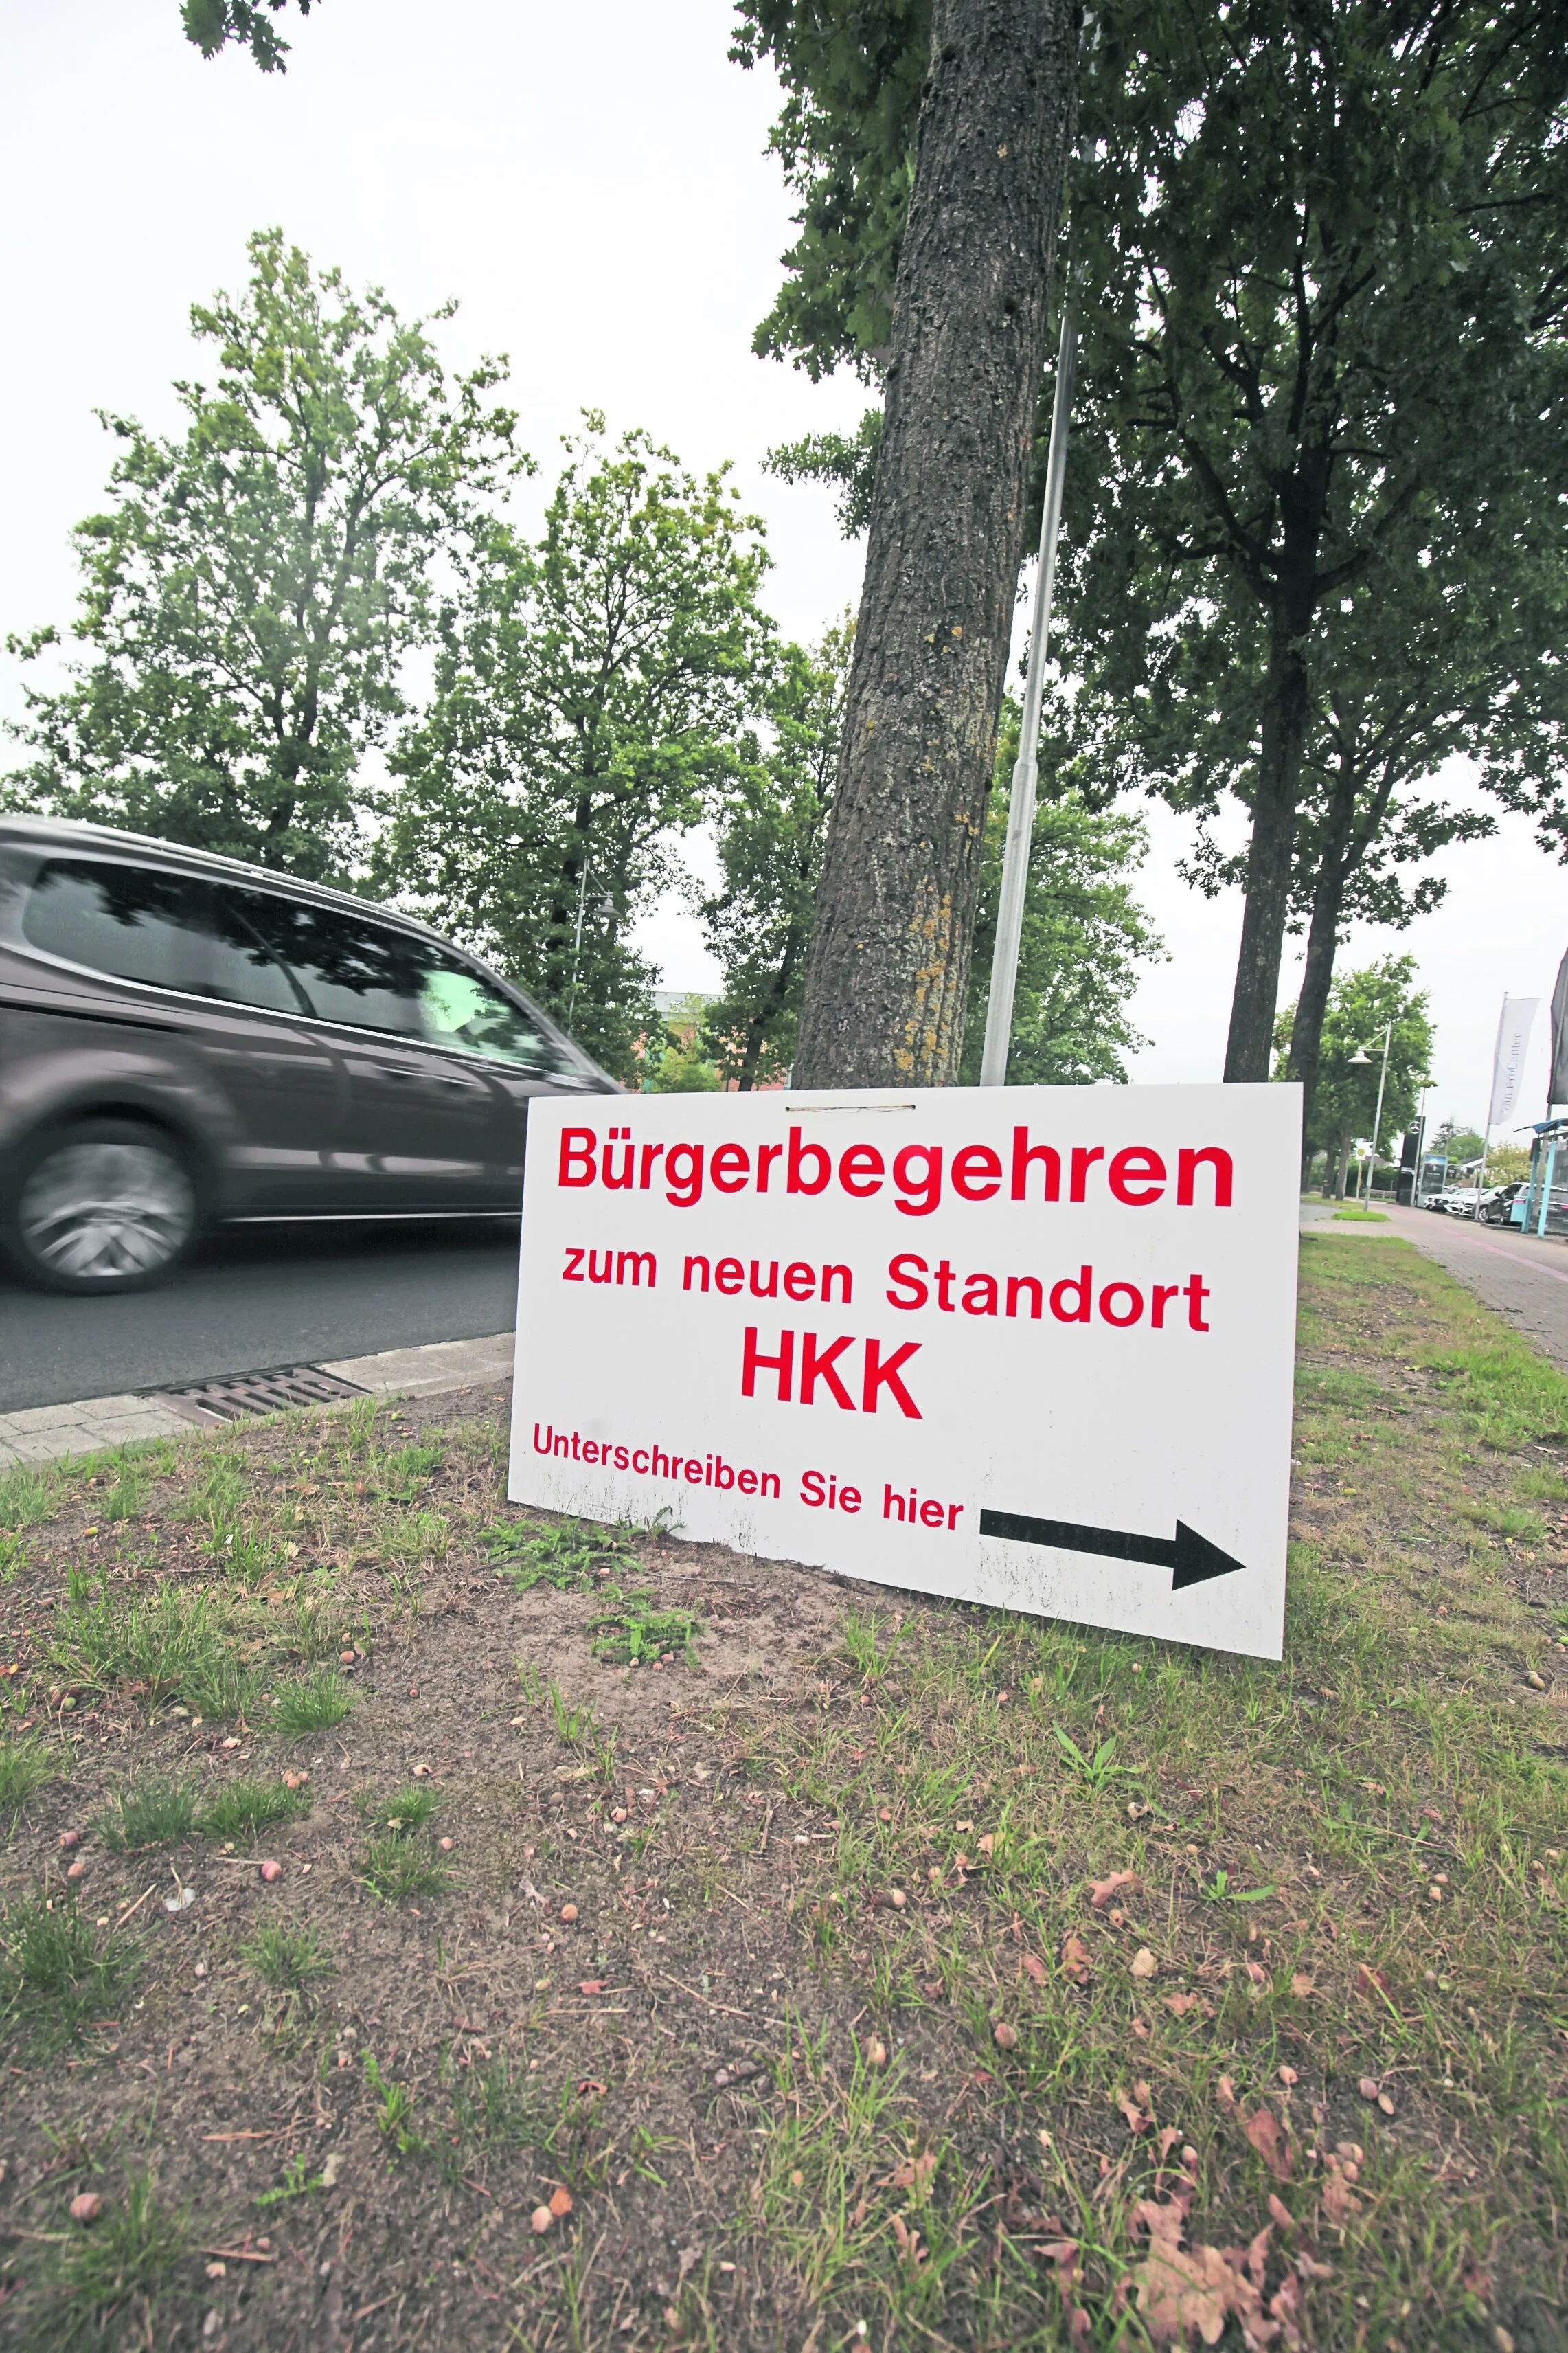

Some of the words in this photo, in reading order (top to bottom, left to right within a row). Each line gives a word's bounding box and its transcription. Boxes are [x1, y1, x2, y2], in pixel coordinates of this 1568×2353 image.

[1506, 1033, 1521, 1088] ProCenter
[558, 1125, 1234, 1217] Bürgerbegehren
[562, 1247, 657, 1287] zum
[682, 1255, 853, 1304] neuen
[885, 1252, 1211, 1332] Standort
[741, 1326, 924, 1420] HKK
[534, 1423, 781, 1499] Unterschreiben
[799, 1470, 862, 1513] Sie
[883, 1483, 964, 1531] hier
